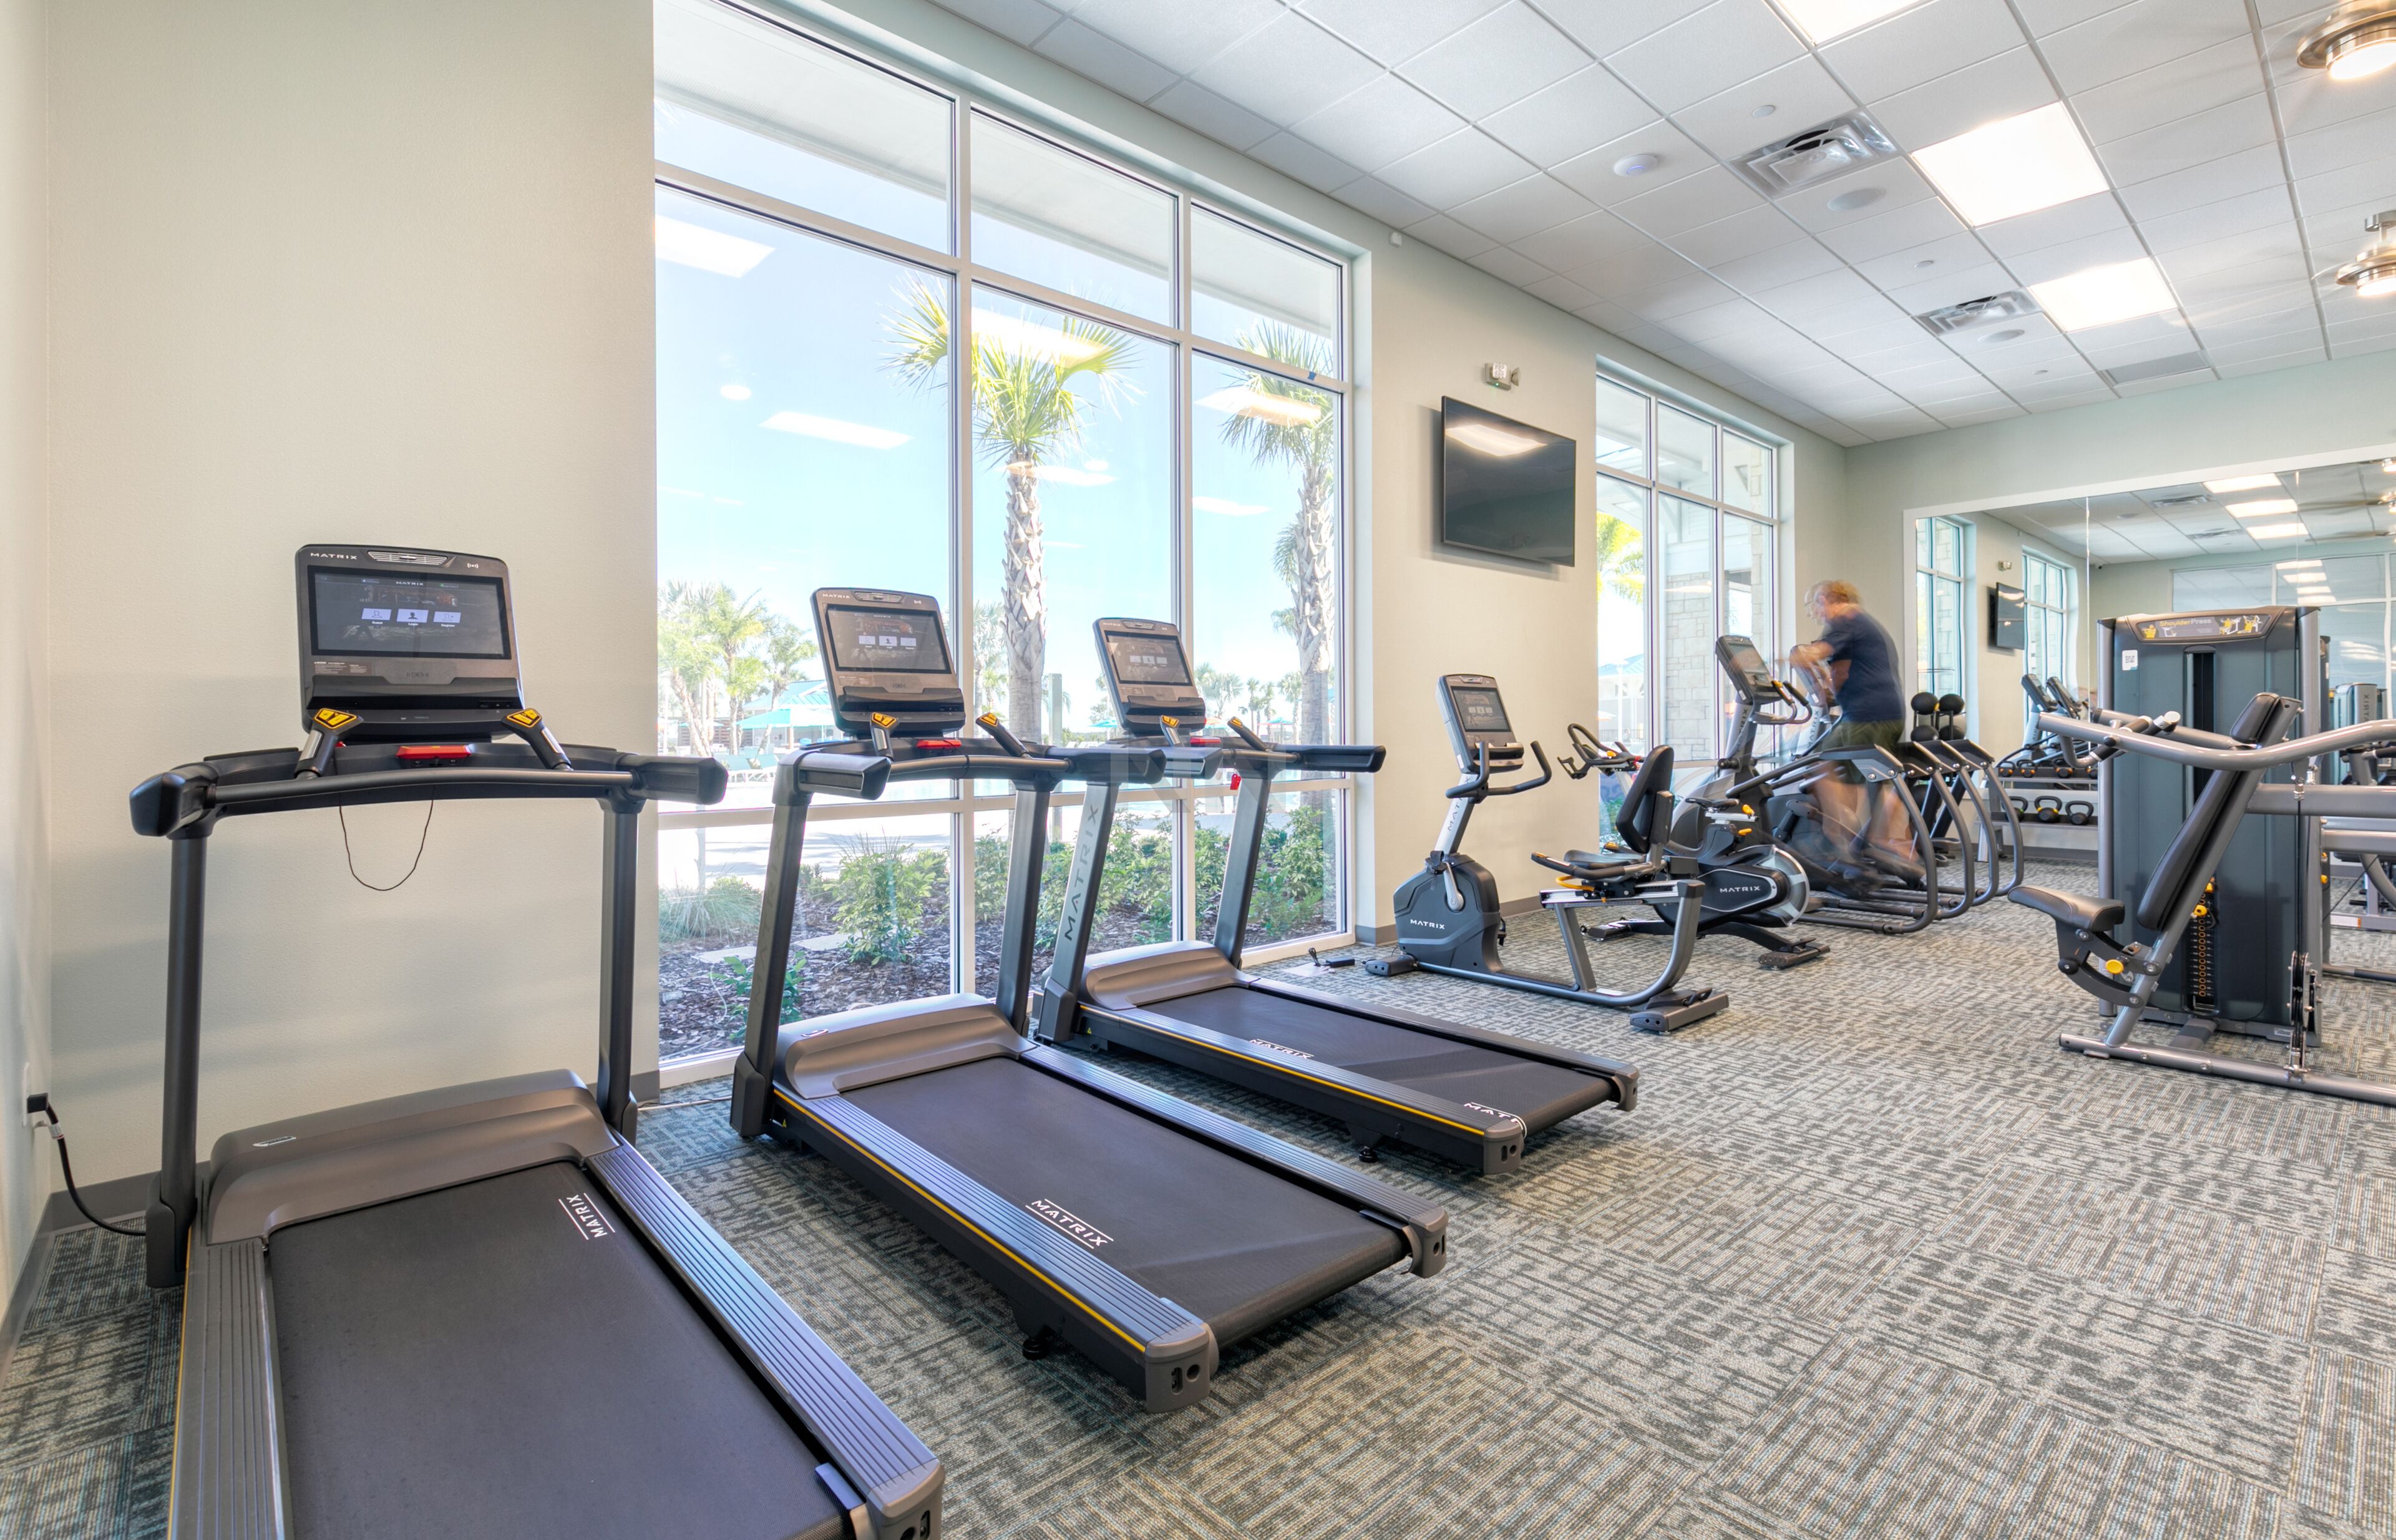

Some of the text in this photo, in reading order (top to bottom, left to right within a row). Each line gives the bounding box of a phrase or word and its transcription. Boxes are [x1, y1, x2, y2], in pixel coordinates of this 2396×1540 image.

[1064, 804, 1099, 941] MATRIX
[1410, 919, 1445, 930] MATRIX
[1249, 1039, 1312, 1059] MATRIX
[566, 1194, 608, 1238] MATRIX
[1031, 1200, 1108, 1247] MATRIX
